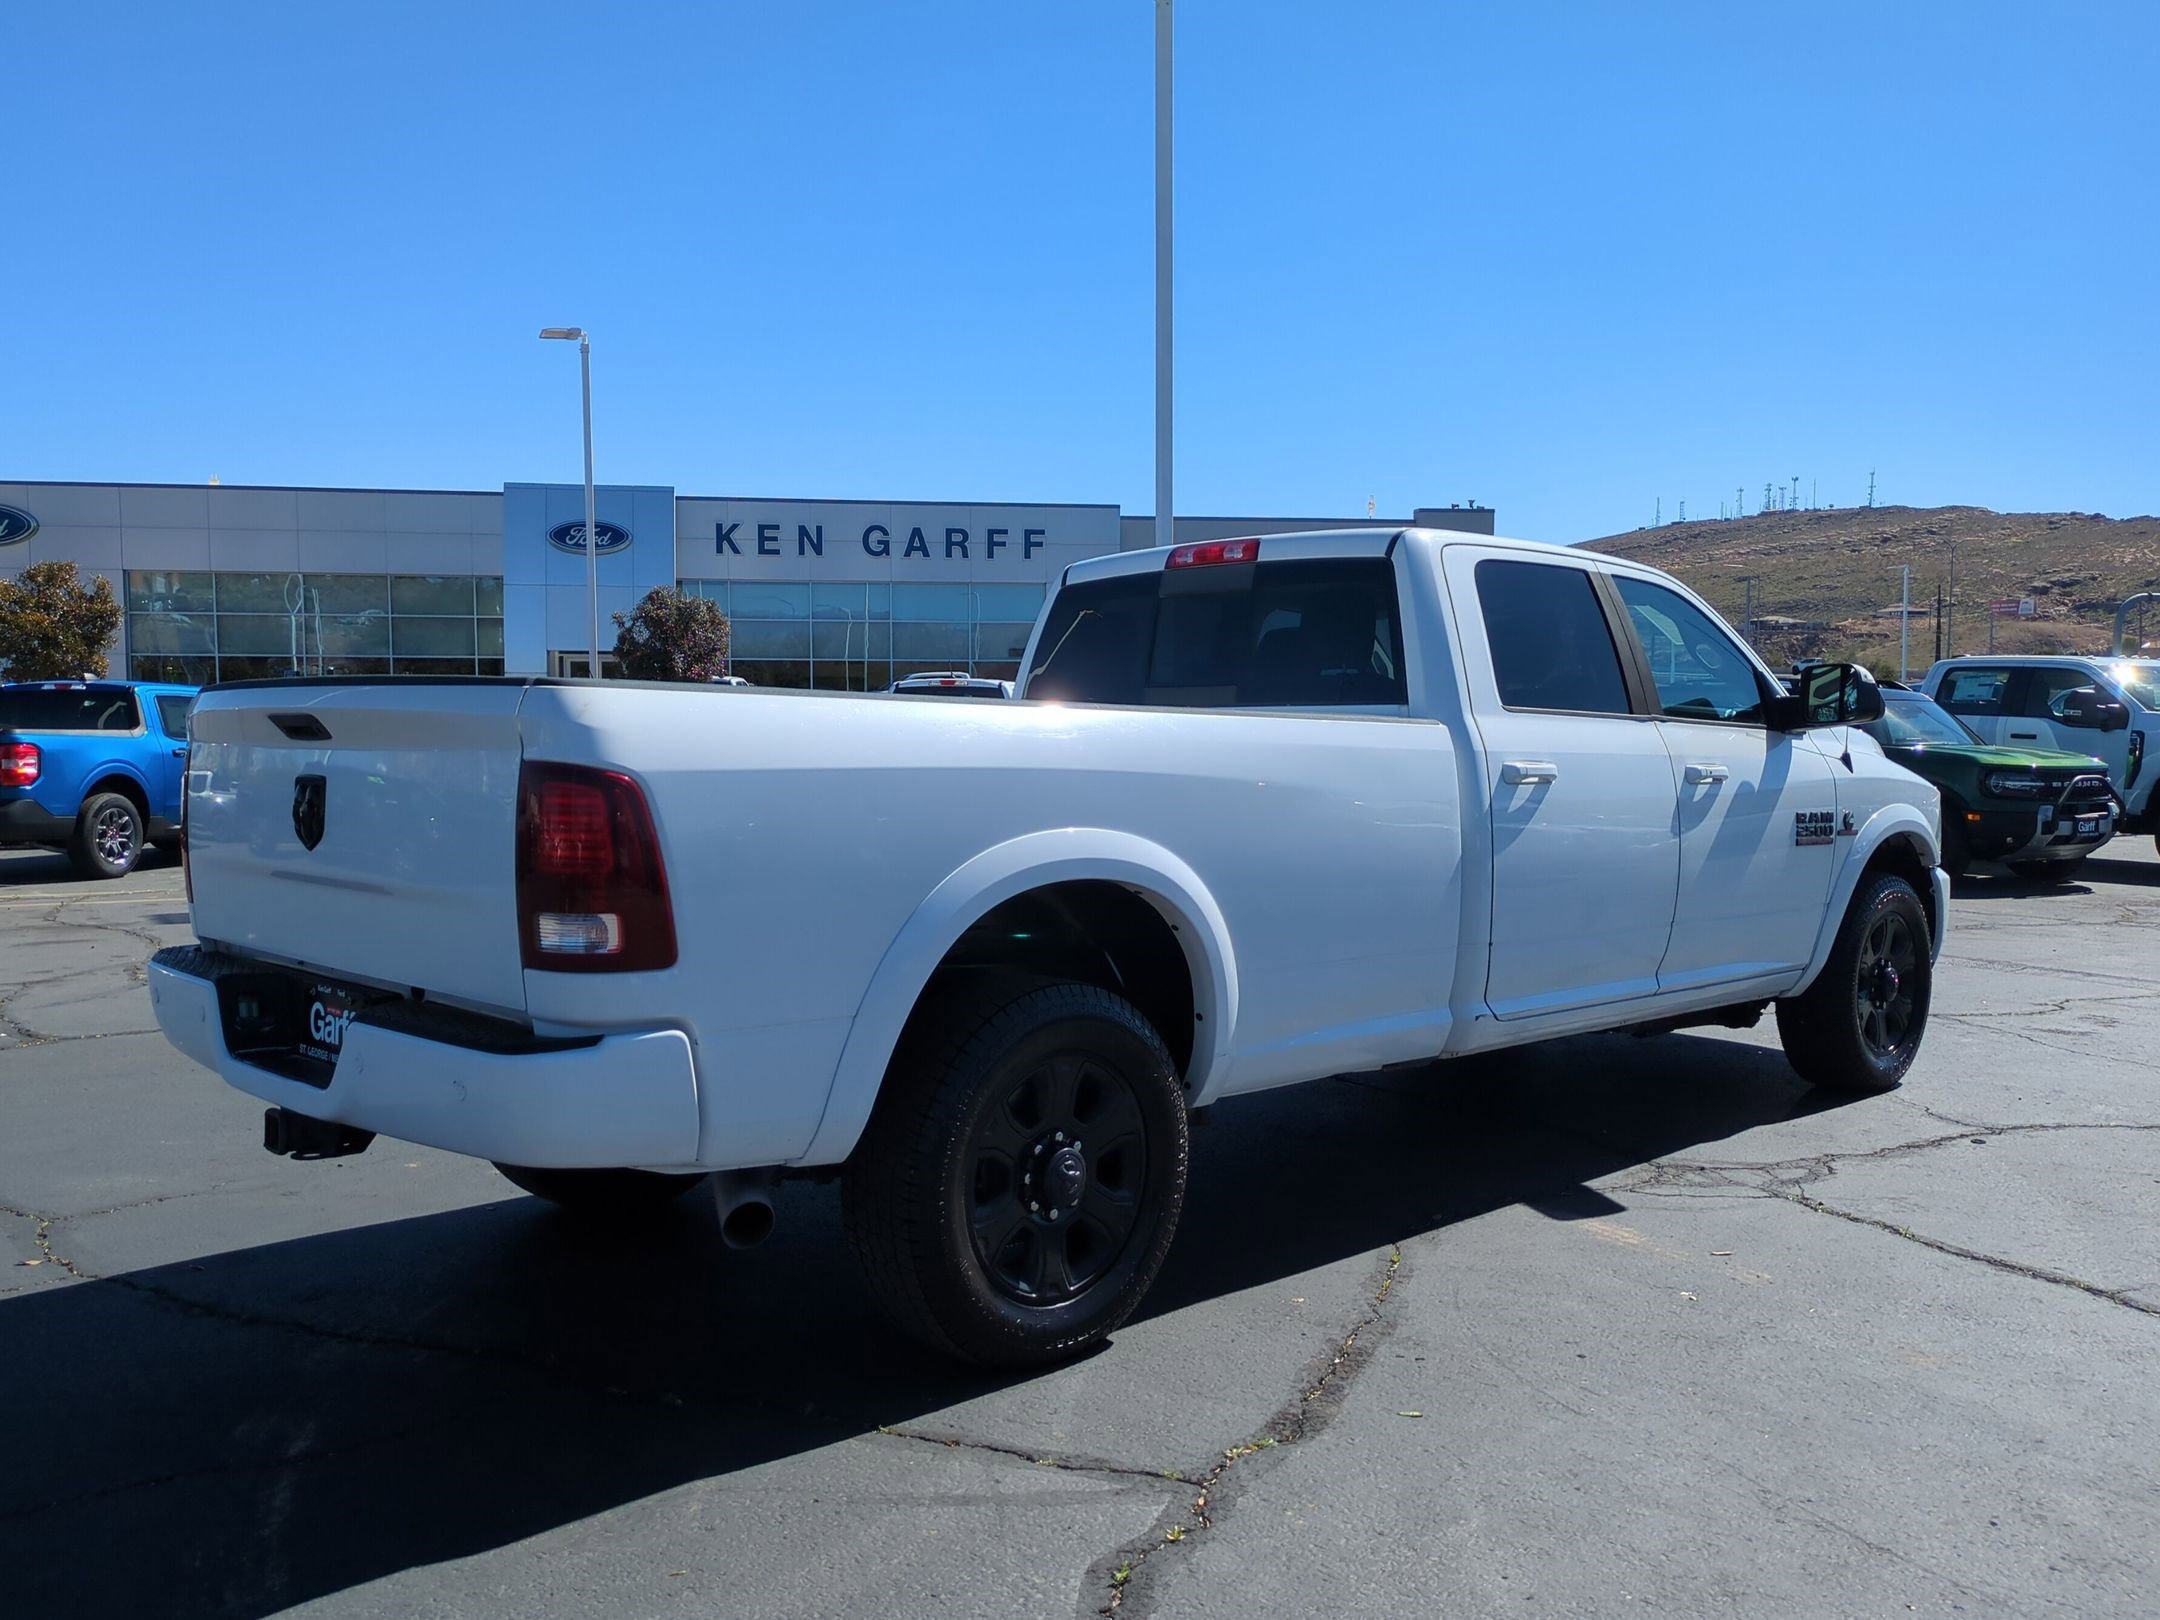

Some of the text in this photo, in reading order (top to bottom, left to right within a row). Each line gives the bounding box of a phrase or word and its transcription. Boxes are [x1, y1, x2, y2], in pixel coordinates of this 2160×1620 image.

[565, 526, 612, 545] Fod
[715, 522, 1046, 560] KEN GARFF
